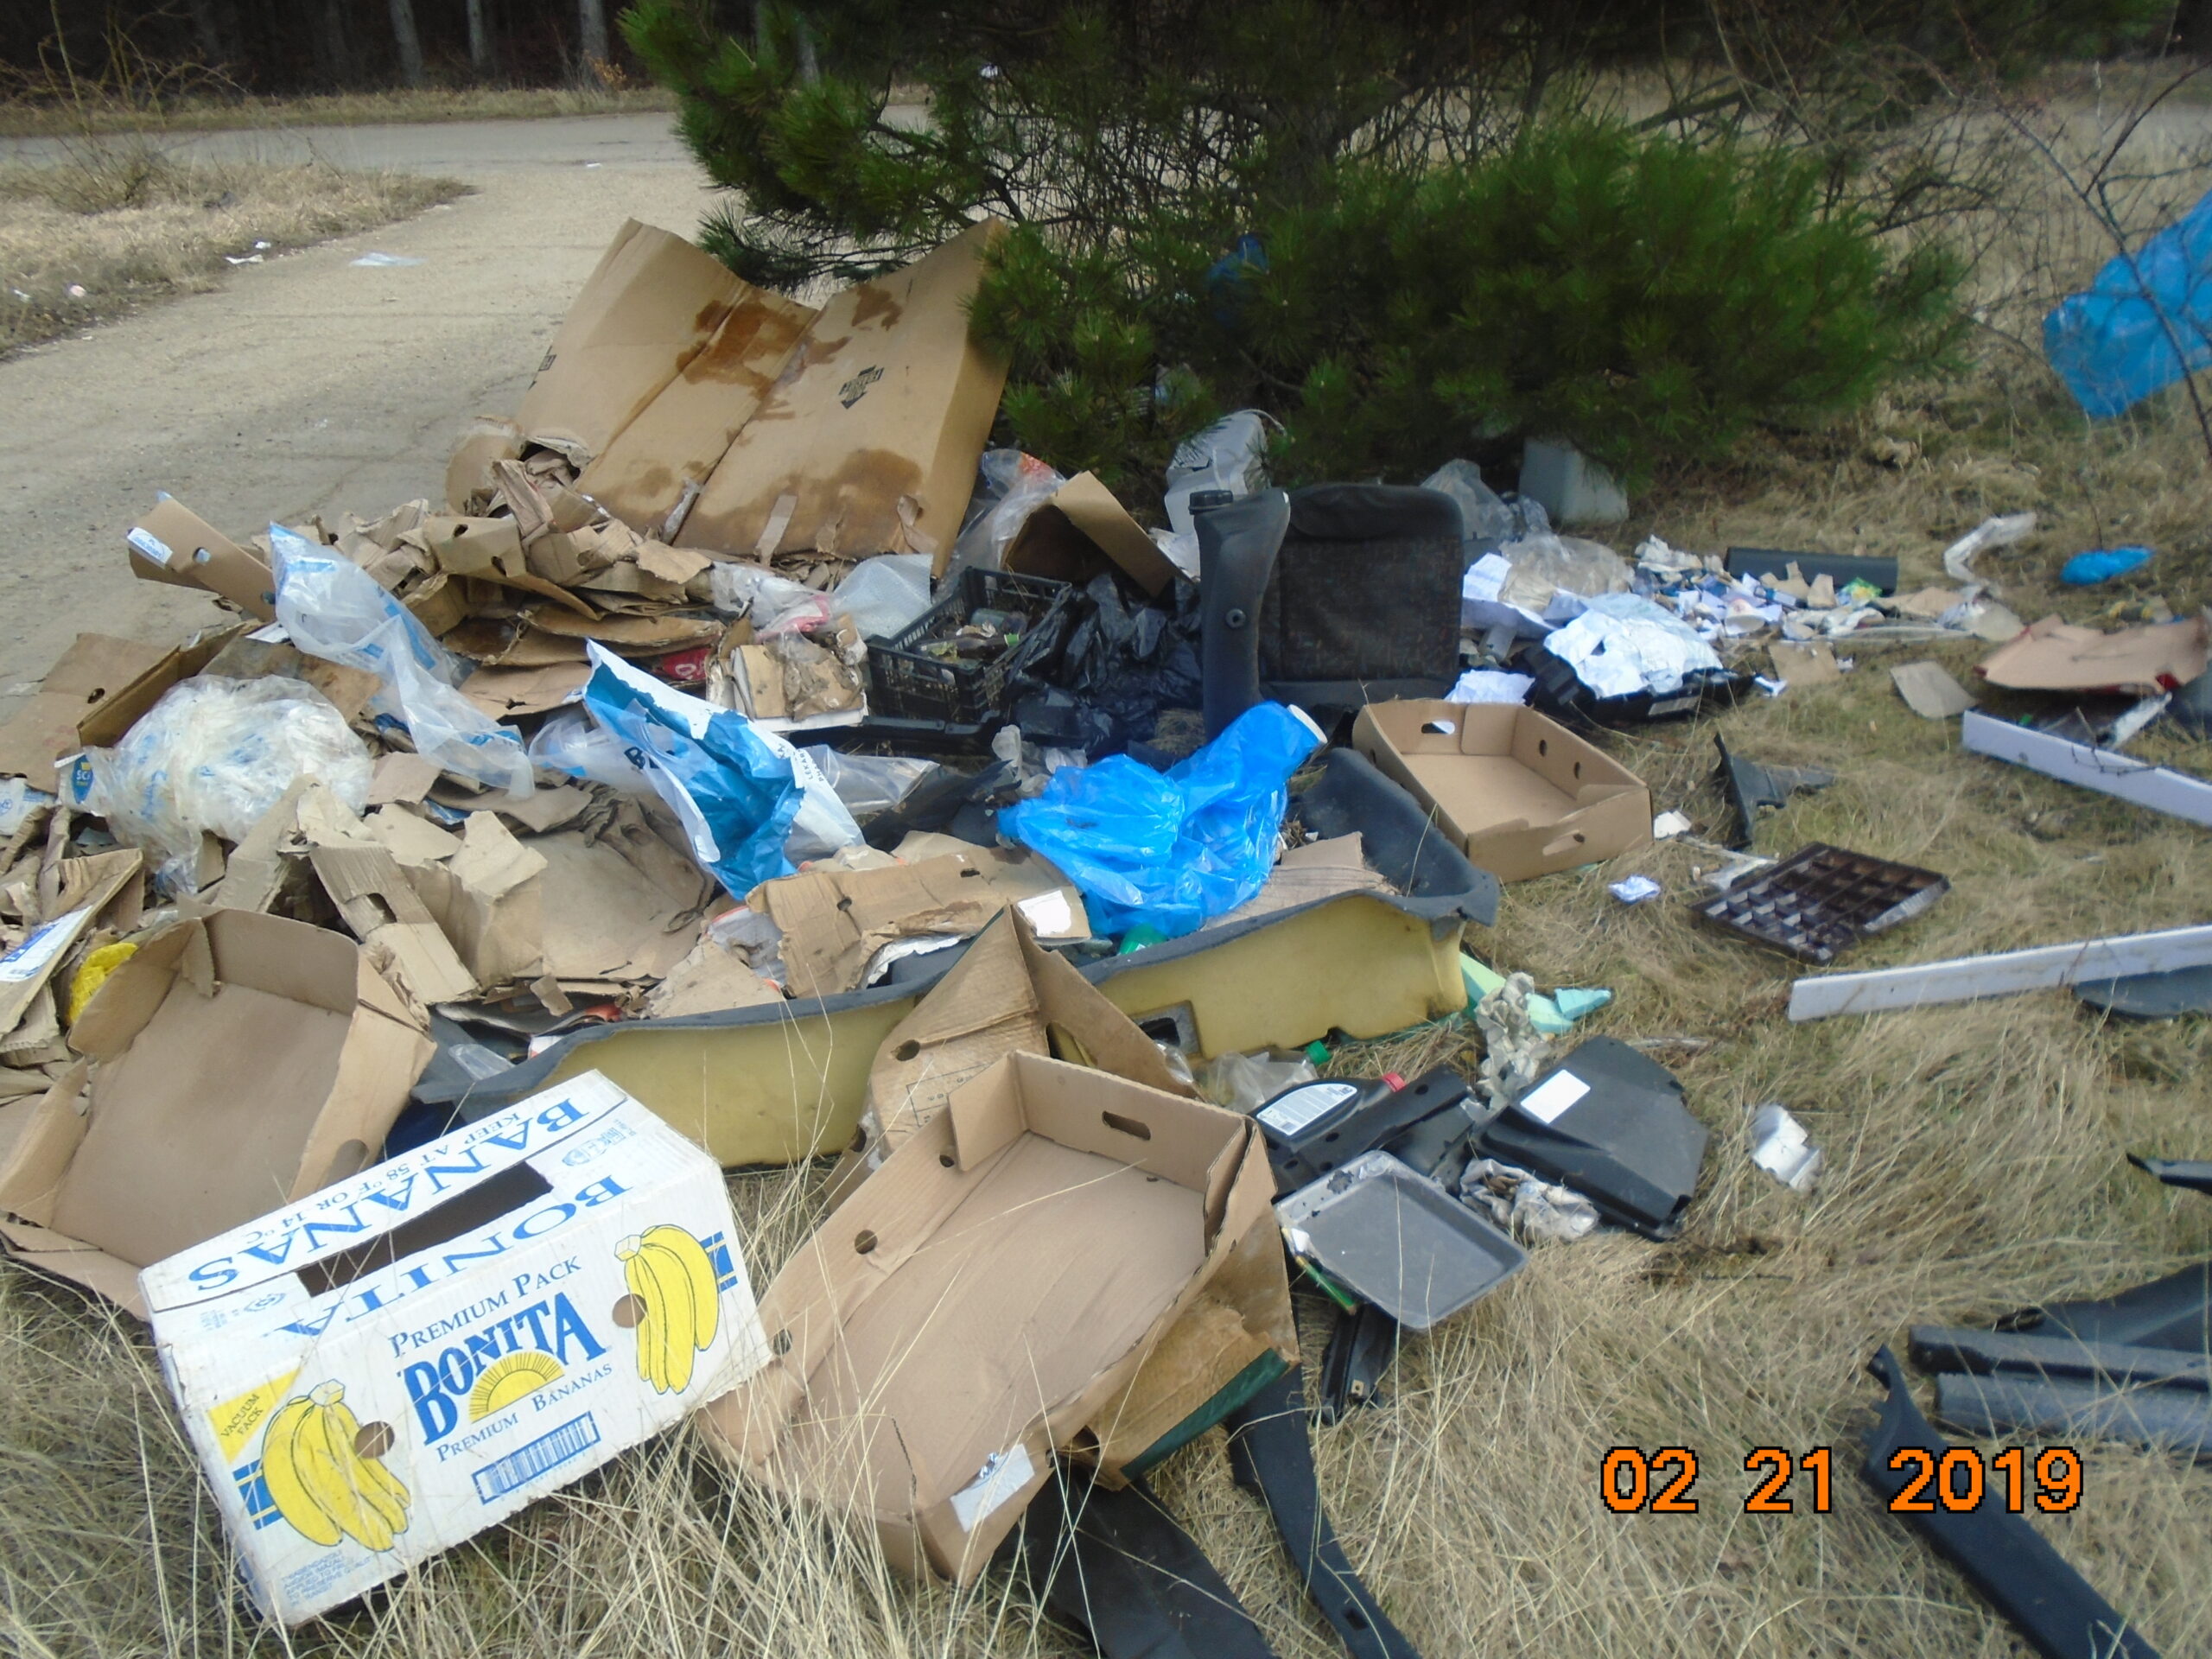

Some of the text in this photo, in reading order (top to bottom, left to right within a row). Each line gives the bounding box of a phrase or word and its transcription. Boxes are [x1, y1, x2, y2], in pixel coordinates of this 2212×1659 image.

[464, 1112, 520, 1144] KEEP
[386, 1161, 410, 1180] 58
[421, 1144, 449, 1165] AT
[188, 1098, 590, 1291] BANANAS
[317, 1192, 348, 1211] OR
[281, 1210, 308, 1227] 14
[263, 1175, 633, 1338] BONITA
[388, 1256, 582, 1358] PREMIUM PACK
[397, 1292, 608, 1446] BONITA
[221, 1393, 260, 1437] VACUUM
[237, 1407, 264, 1434] PACK
[435, 1363, 613, 1463] PREMIUM BANANAS
